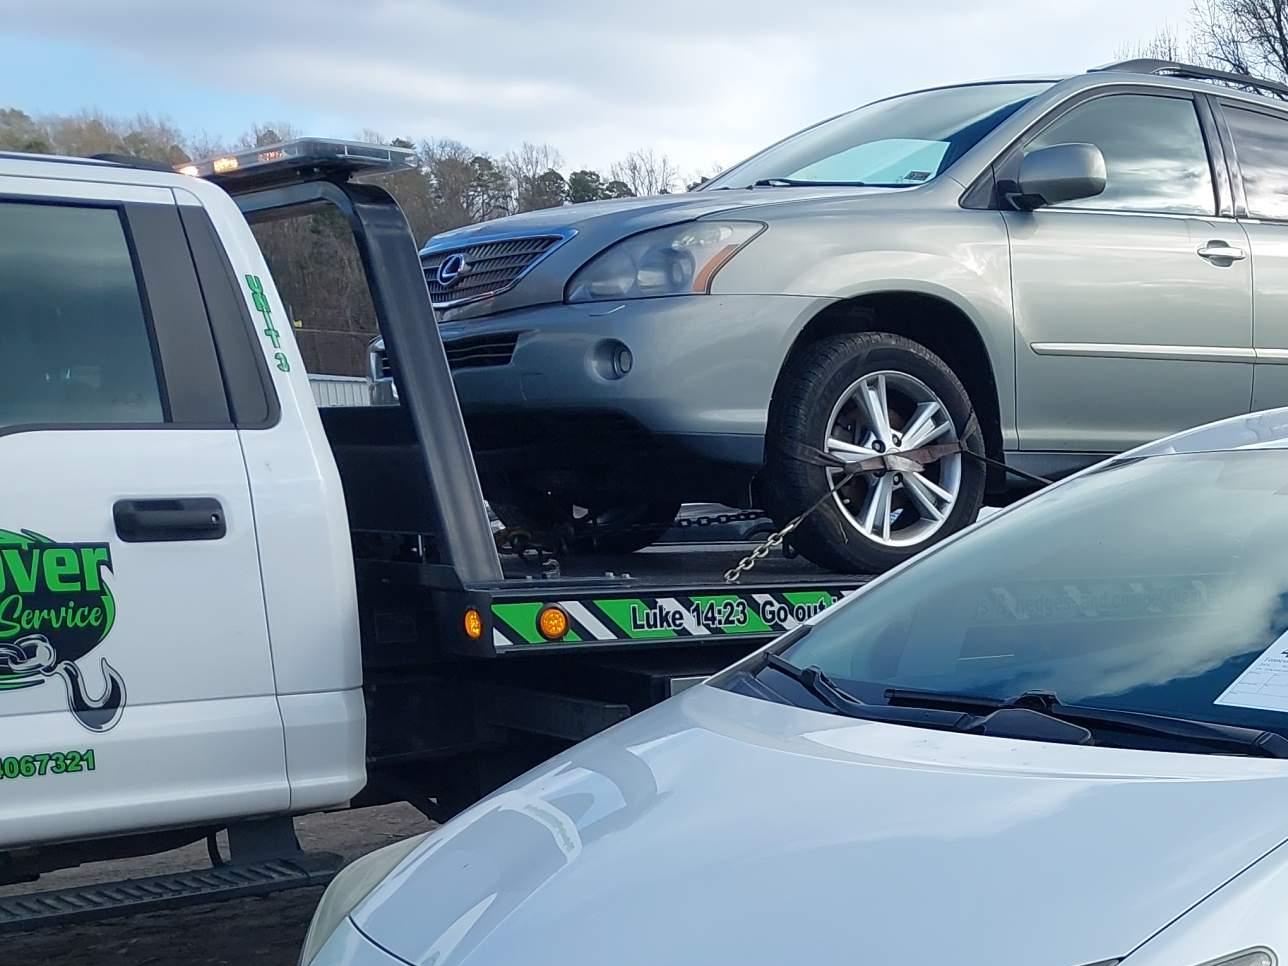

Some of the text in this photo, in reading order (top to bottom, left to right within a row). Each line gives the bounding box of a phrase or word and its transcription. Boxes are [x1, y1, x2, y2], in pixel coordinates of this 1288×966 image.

[274, 352, 290, 372] 3
[0, 548, 109, 593] ver
[0, 594, 104, 637] Service
[631, 602, 684, 631] Luke
[692, 600, 748, 628] 14:23
[760, 599, 789, 625] Go
[0, 748, 96, 779] 067321
